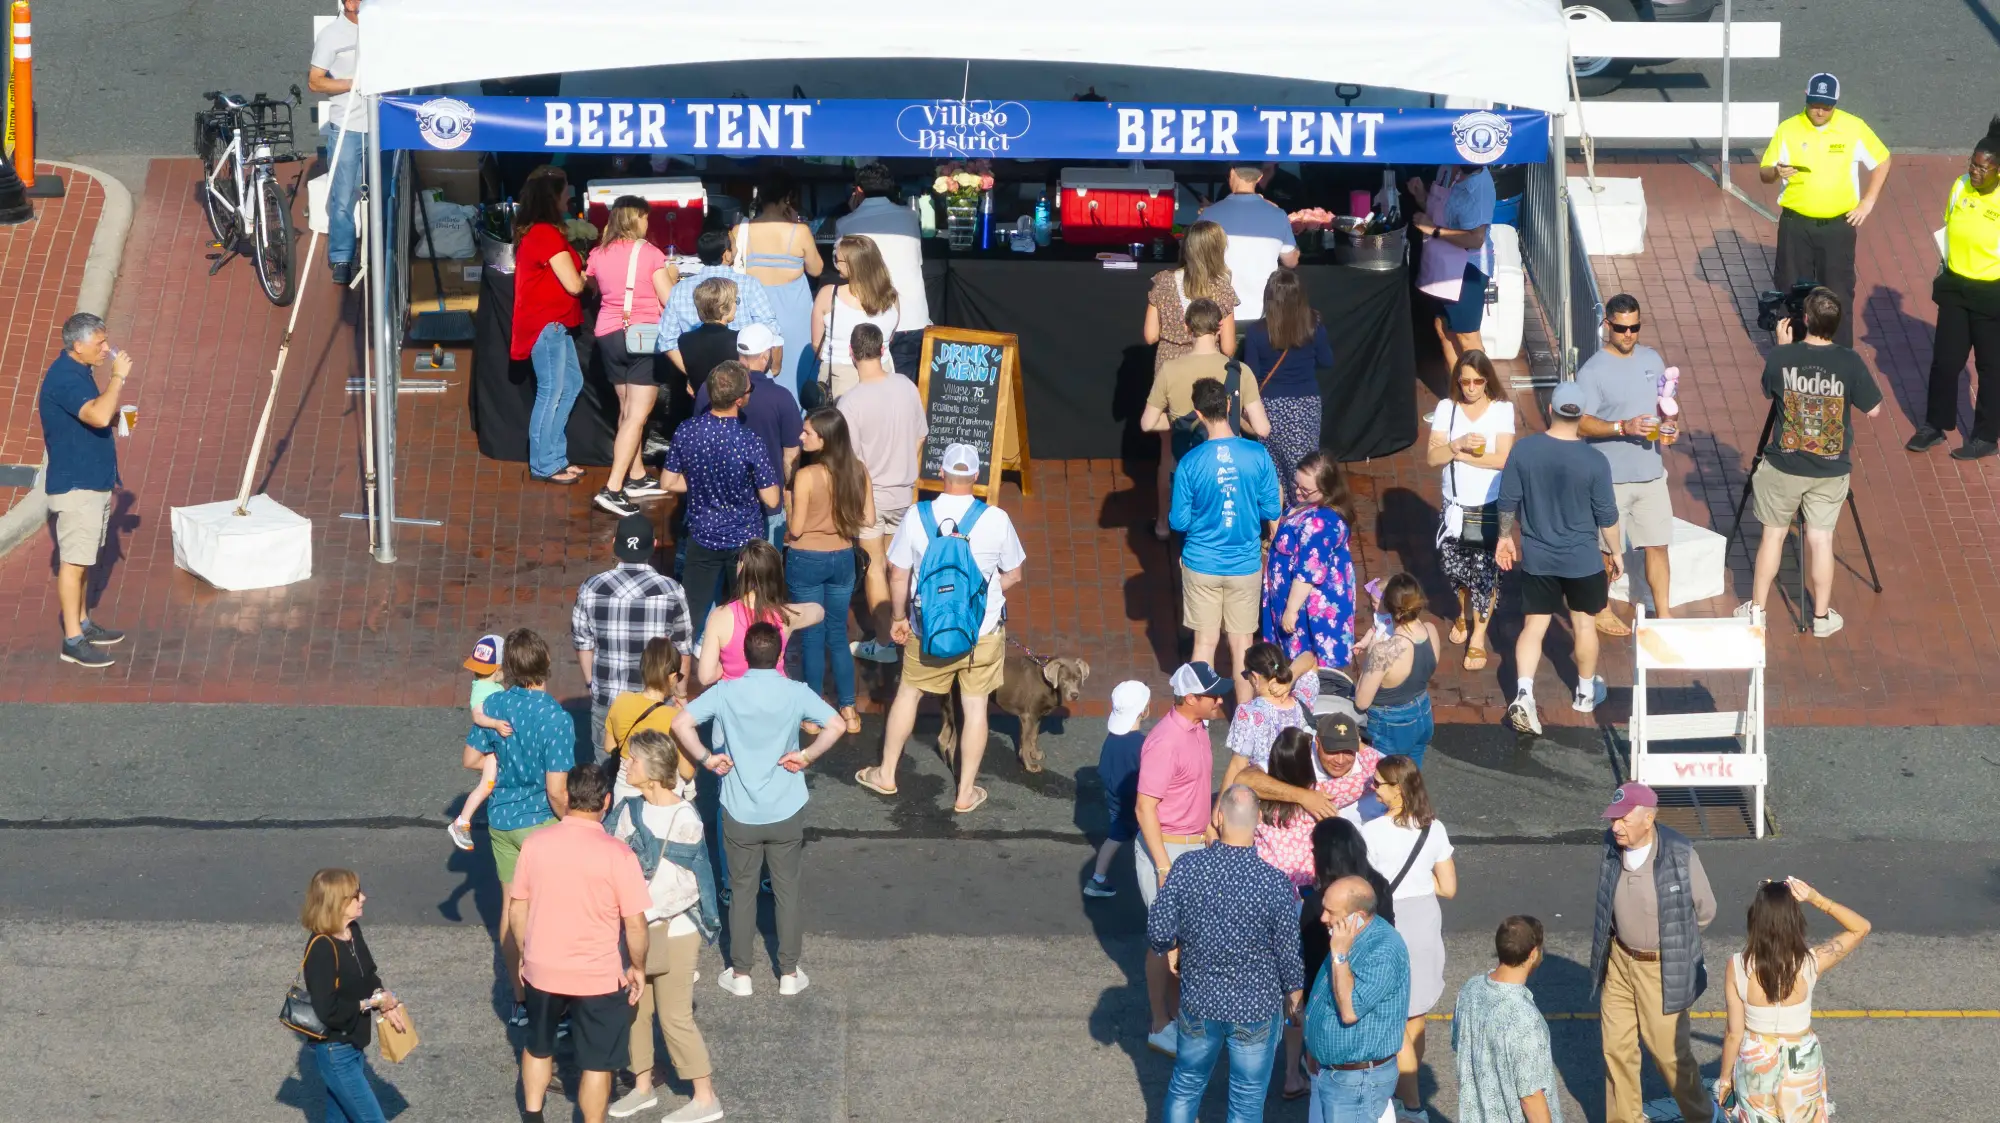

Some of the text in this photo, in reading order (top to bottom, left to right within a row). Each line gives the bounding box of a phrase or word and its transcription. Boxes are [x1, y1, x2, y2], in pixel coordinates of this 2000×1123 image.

[545, 103, 811, 149] BEER TENT
[922, 105, 1007, 129] Village
[918, 129, 1010, 151] District
[1117, 108, 1384, 156] BEER TENT
[940, 343, 991, 367] DRINK
[945, 362, 997, 386] MENU!
[1782, 366, 1845, 397] Modelo
[943, 384, 985, 398] Village 75
[956, 426, 971, 436] Pinot
[973, 428, 988, 439] Noir
[959, 416, 993, 430] Chardonnay
